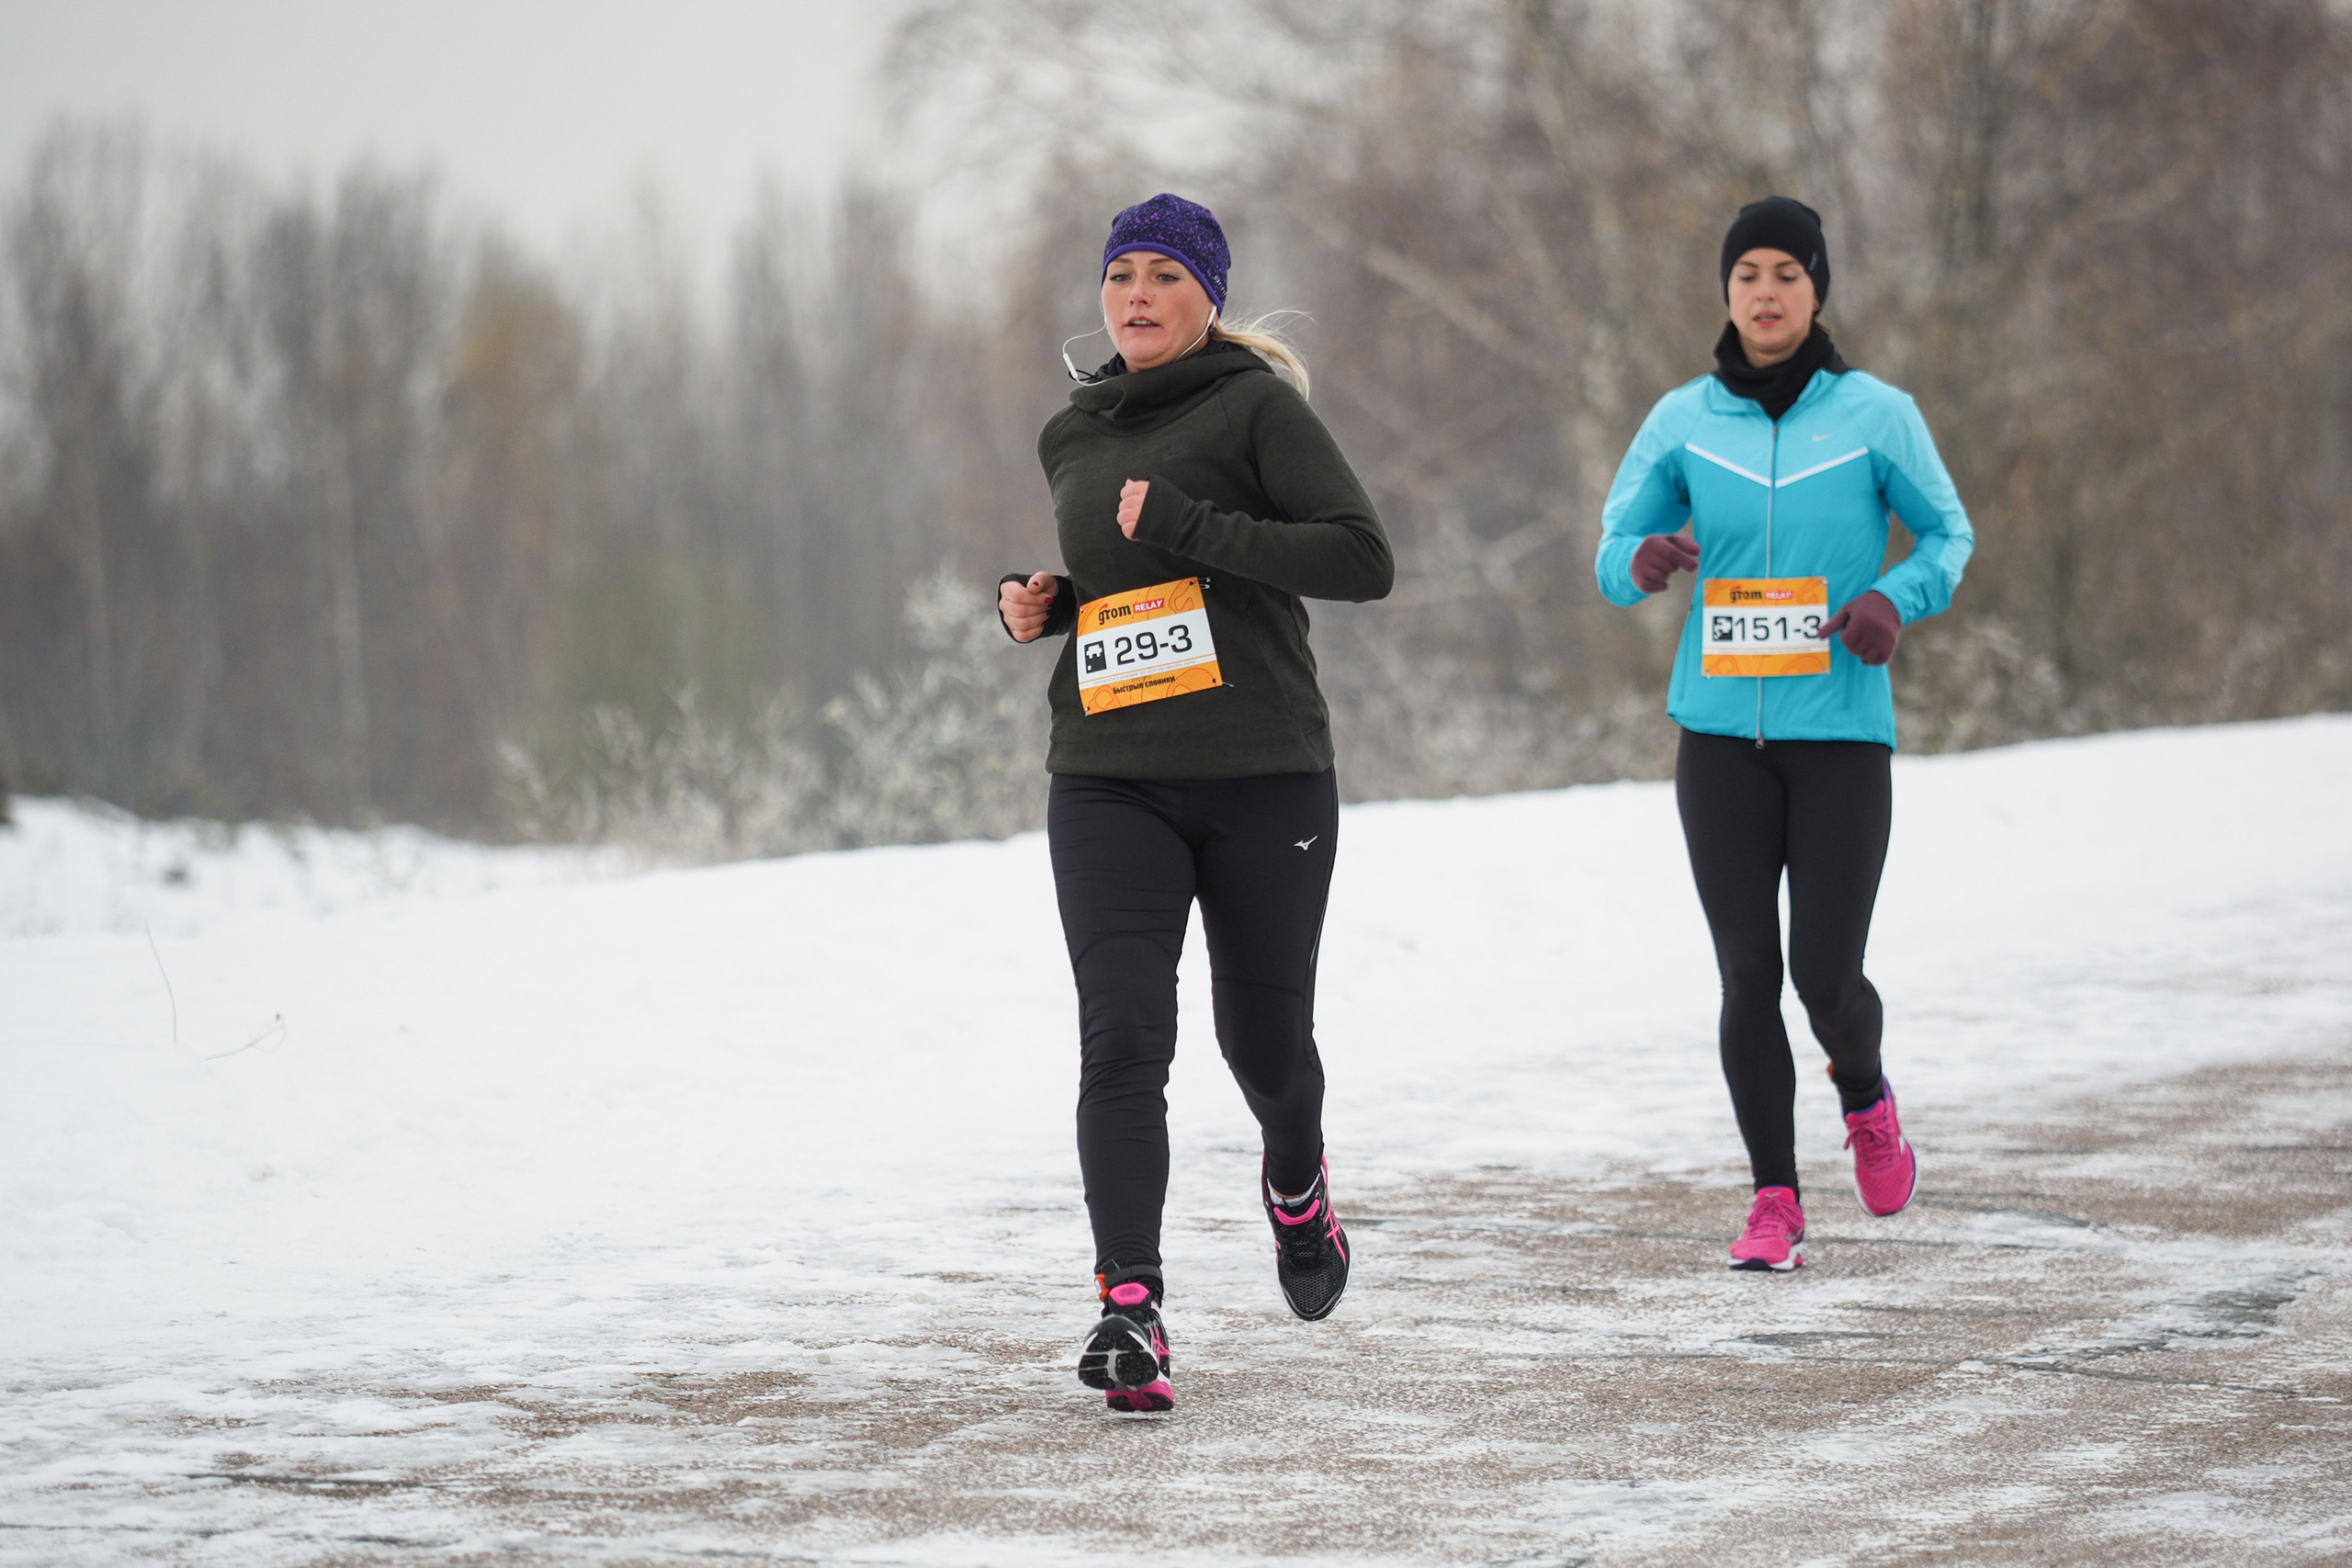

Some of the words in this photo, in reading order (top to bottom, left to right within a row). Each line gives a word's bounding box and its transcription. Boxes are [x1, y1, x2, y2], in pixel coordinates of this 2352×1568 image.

[1730, 589, 1762, 604] grom
[1099, 603, 1131, 625] grom
[1134, 599, 1163, 613] RELAY
[1734, 615, 1821, 641] 151-3
[1114, 625, 1193, 666] 29-3
[1113, 682, 1144, 694] быстрые
[1145, 676, 1176, 688] слоники
